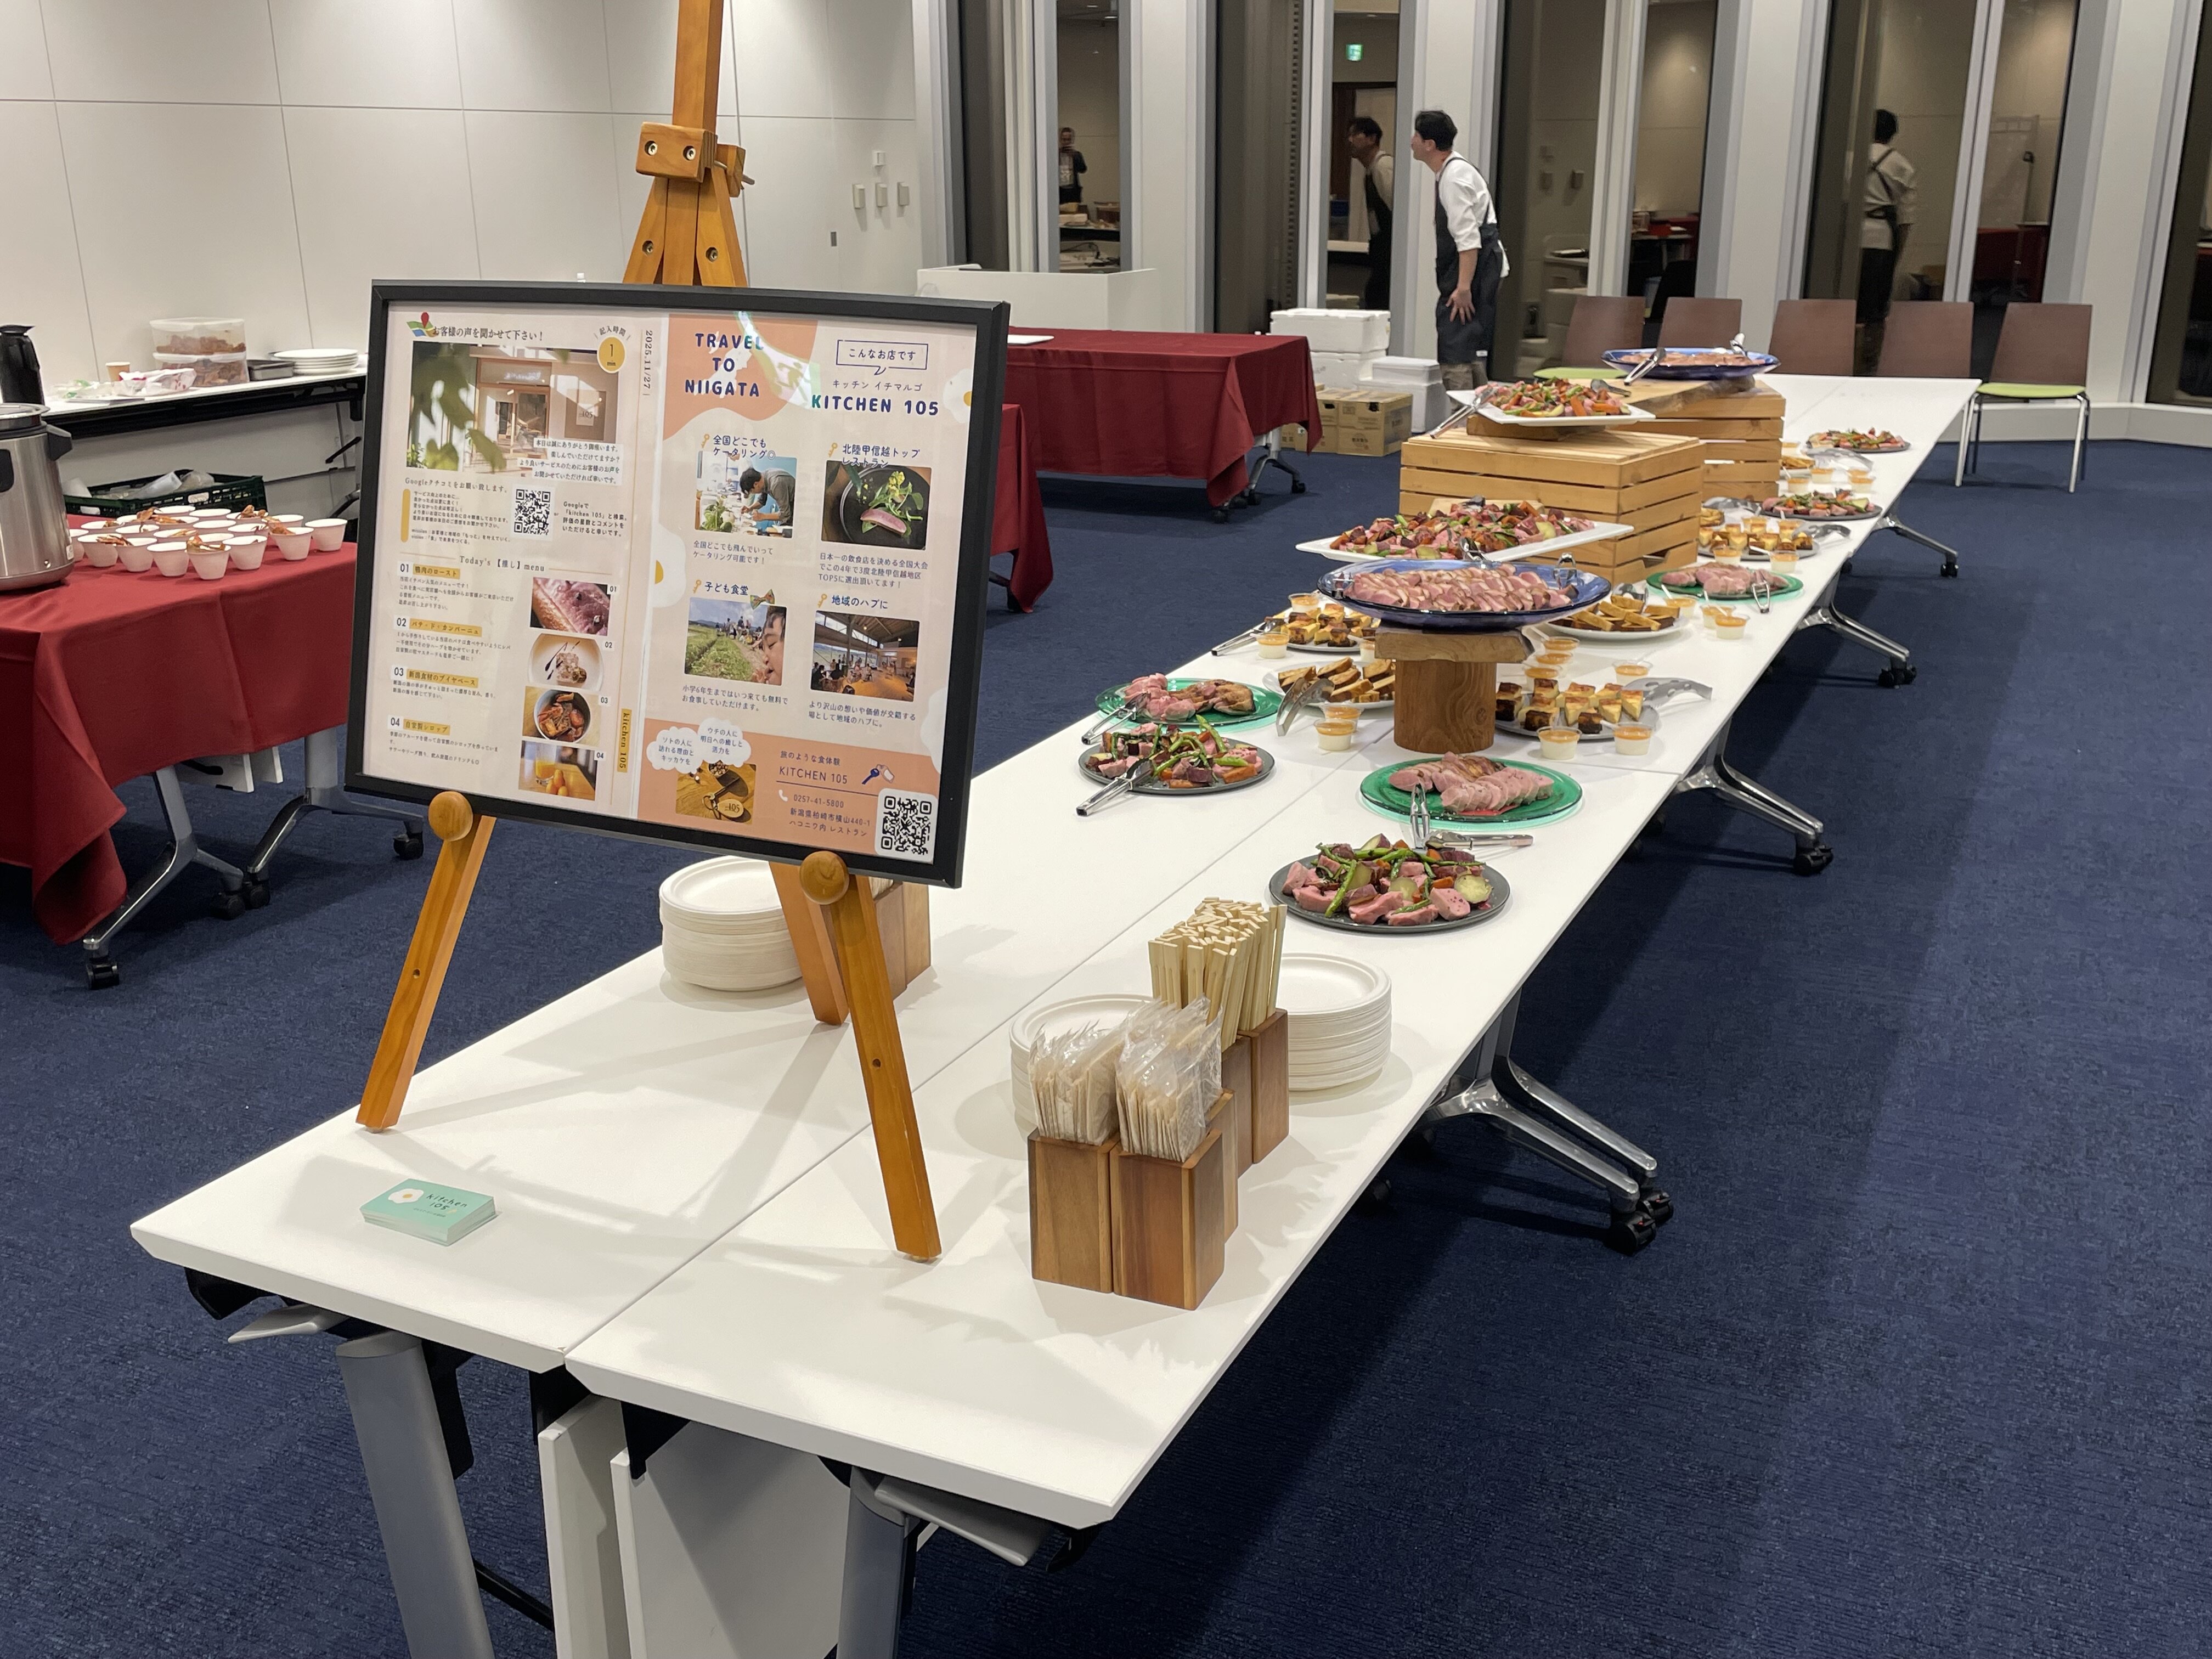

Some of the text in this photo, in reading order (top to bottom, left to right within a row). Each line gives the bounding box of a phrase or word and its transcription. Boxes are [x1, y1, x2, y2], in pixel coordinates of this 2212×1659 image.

[599, 325, 626, 337] 記入時間
[695, 333, 764, 350] TRAVEL
[644, 330, 653, 389] 2025.11/27
[849, 348, 916, 360] こんなお店です
[712, 358, 735, 372] TO
[685, 380, 759, 397] NIIGATA
[833, 380, 922, 391] キッチン イチマルゴ
[812, 394, 938, 415] KITCHEN 105
[713, 435, 766, 448] 全国どこでも
[843, 444, 921, 458] 北陸甲信越トップ
[842, 457, 889, 468] レストラン
[693, 540, 774, 555] 全国どこでも飛んでいって
[460, 556, 490, 566] Today's
[693, 551, 764, 564] ケータリング可能です！
[820, 552, 928, 569] 日本一の飲食店を決める全国大会
[400, 563, 409, 573] 01
[415, 566, 457, 577] 鴨肉のロースト
[820, 563, 922, 579] でこの4年で3度北陸甲信越地区
[818, 573, 900, 588] TOP5に選出頂いてます！
[704, 582, 749, 596] 子ども食堂
[832, 595, 888, 609] 地域のハブに
[397, 618, 406, 627] 02
[394, 667, 404, 676] 03
[682, 684, 788, 704] 小学6年生まではいつ来ても無料で
[682, 696, 759, 711] お食事していただけます。
[809, 701, 916, 721] より沢山の想いや価値が交錯する
[391, 717, 400, 726] 04
[809, 711, 882, 727] 場として地域のハブに。
[406, 721, 448, 733] 自家製シロップ
[708, 727, 738, 737] ウチの人に
[619, 713, 630, 769] kitchen 105
[701, 736, 743, 747] 明日への癒しと
[658, 745, 694, 756] 訪れる理由と
[712, 746, 730, 755] 活力を
[661, 755, 690, 764] キッカケを
[780, 751, 840, 766] 旅のような食体験
[779, 766, 848, 783] KITCHEN 105
[793, 794, 844, 808] 0257-41-5800
[790, 808, 871, 826] 新潟県柏崎市横山440-1
[789, 821, 867, 836] ハコニワ内 レストラン
[426, 1194, 467, 1207] kitchen
